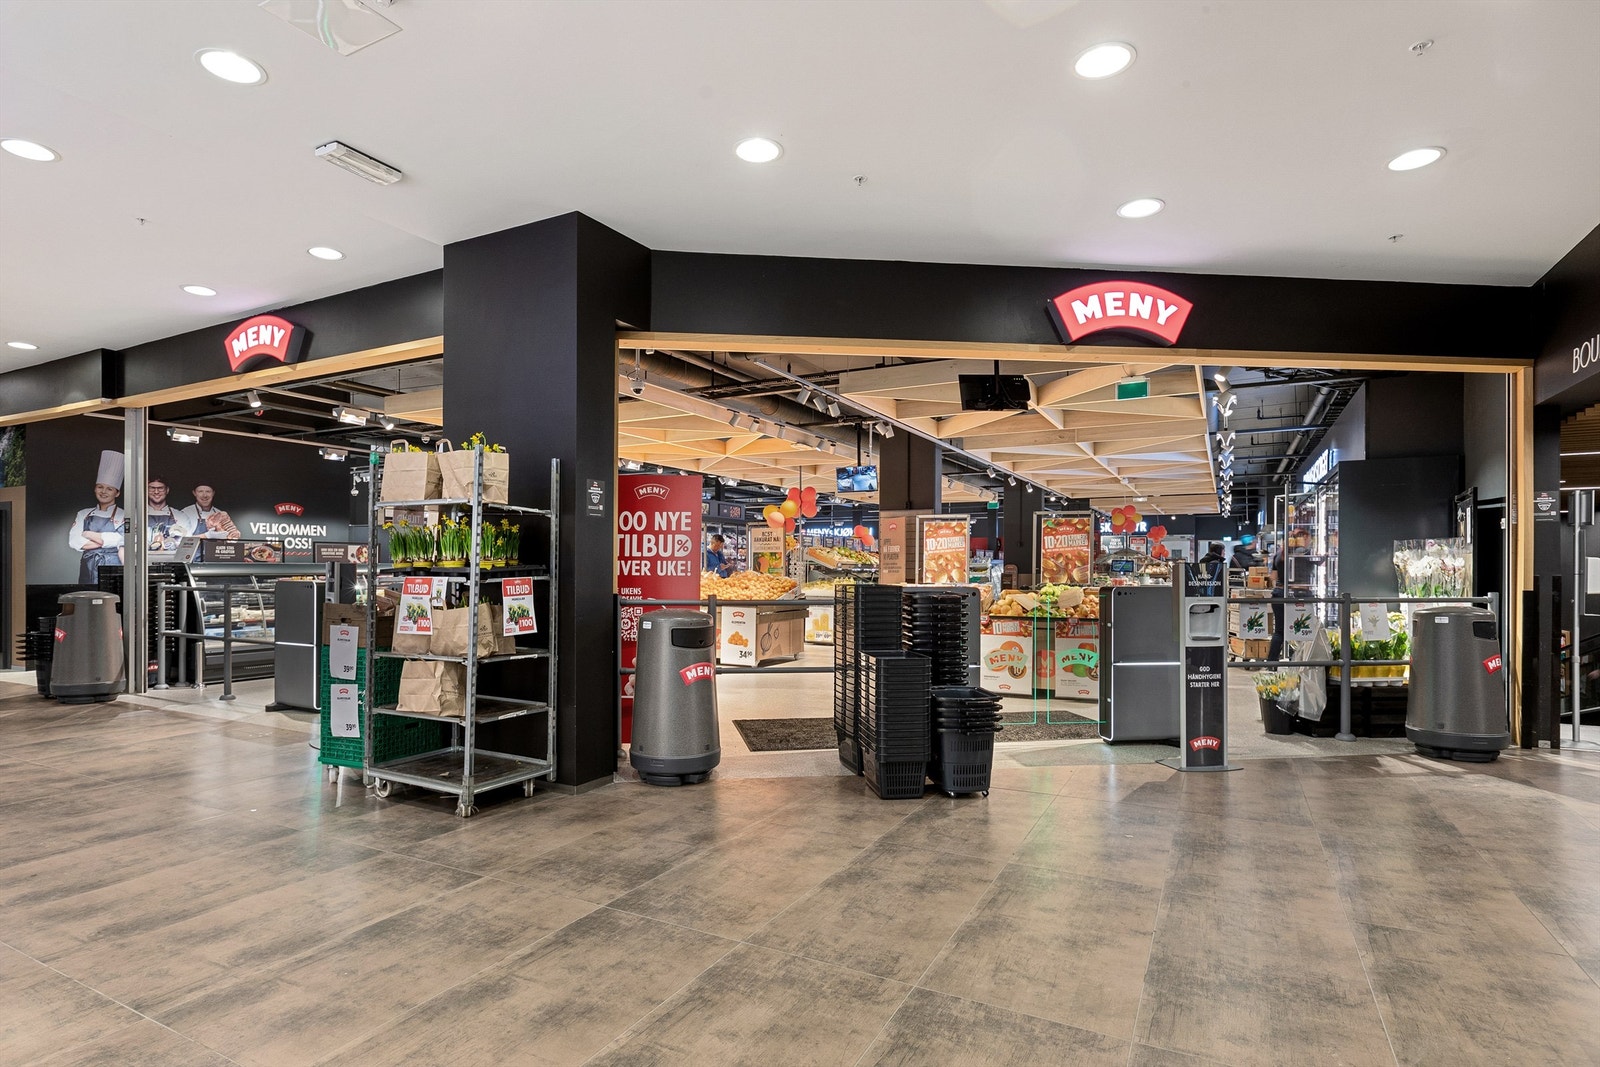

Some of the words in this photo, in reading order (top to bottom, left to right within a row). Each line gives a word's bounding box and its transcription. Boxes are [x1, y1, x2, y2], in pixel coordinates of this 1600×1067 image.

[1070, 291, 1179, 326] MENY
[231, 324, 286, 358] MENY
[1572, 333, 1600, 374] BOU
[639, 486, 666, 496] MENY
[278, 504, 302, 514] MENY
[618, 511, 648, 532] 00
[654, 511, 692, 531] NYE
[249, 522, 328, 537] VELKOMMEN
[284, 537, 313, 550] OSS!
[617, 534, 692, 557] TILBUD
[656, 560, 692, 577] UKE!
[407, 583, 430, 594] TILBUD
[506, 584, 530, 596] TILBUD
[621, 587, 642, 596] UKENS
[989, 653, 1023, 665] MENY
[1061, 652, 1094, 664] MENY
[1488, 657, 1502, 670] ME
[1193, 739, 1218, 748] MENY
